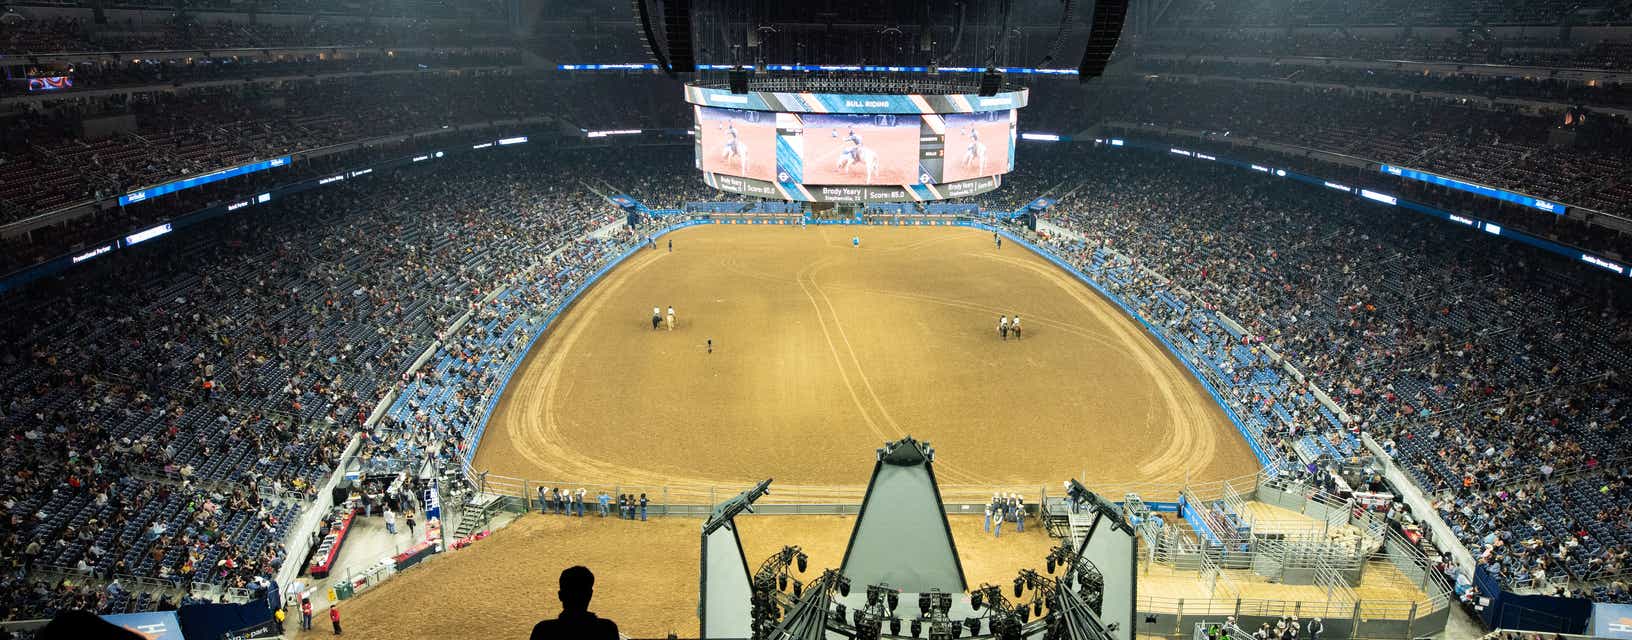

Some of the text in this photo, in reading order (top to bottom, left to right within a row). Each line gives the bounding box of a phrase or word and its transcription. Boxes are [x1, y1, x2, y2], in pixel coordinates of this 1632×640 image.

[822, 187, 861, 196] Brody Yeary
[250, 627, 269, 638] park
